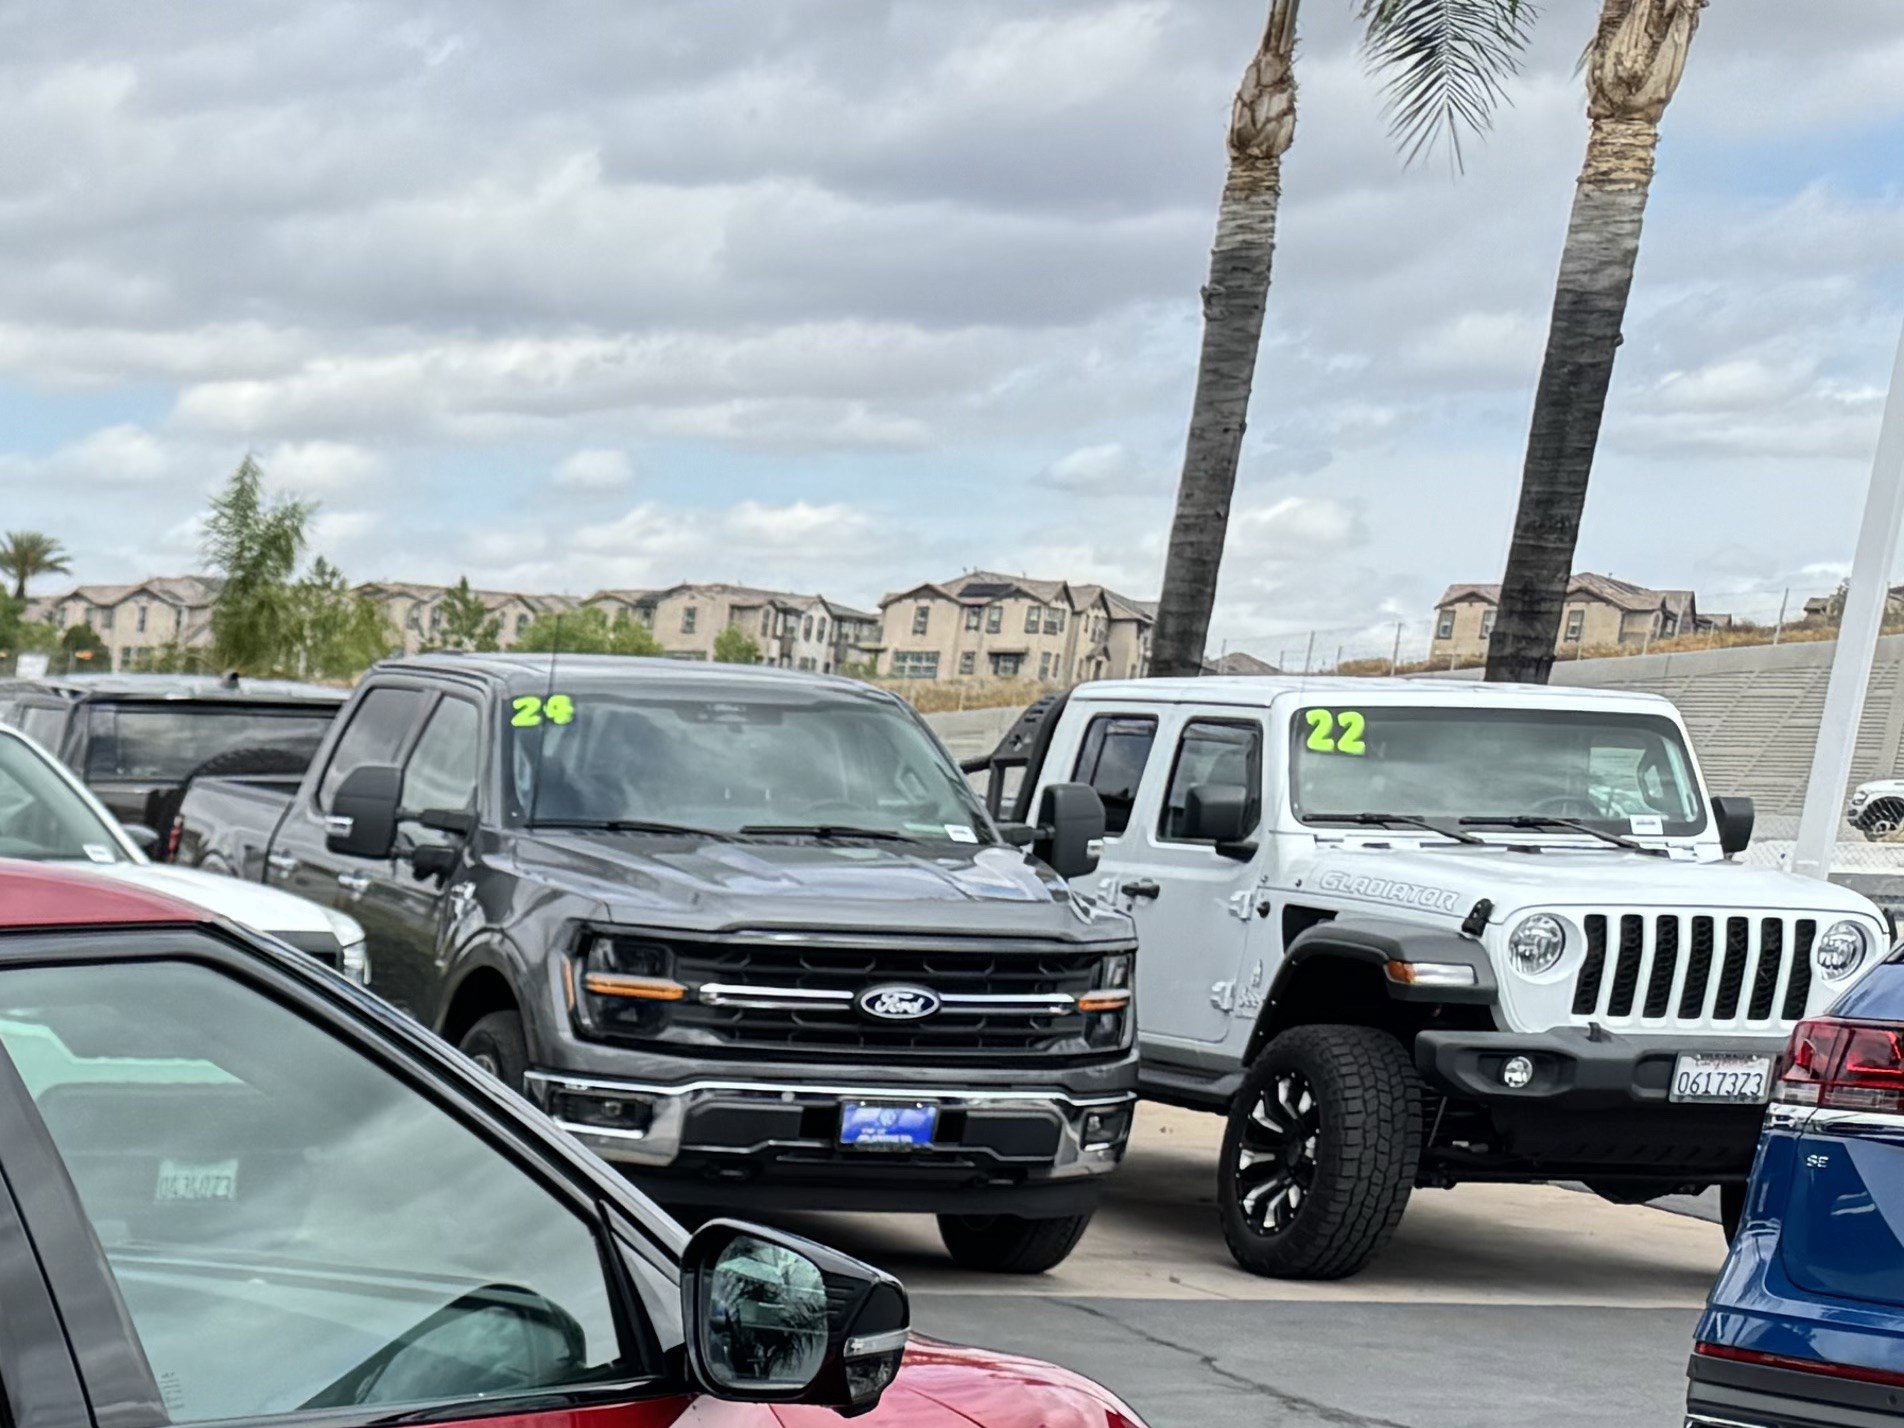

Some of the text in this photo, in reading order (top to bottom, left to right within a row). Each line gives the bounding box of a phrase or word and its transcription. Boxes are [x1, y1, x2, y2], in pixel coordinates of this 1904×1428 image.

[511, 694, 575, 726] 24
[1305, 708, 1366, 756] 22
[1320, 870, 1460, 912] GLADIATOR
[874, 991, 926, 1014] Ford
[1806, 1154, 1829, 1168] SE
